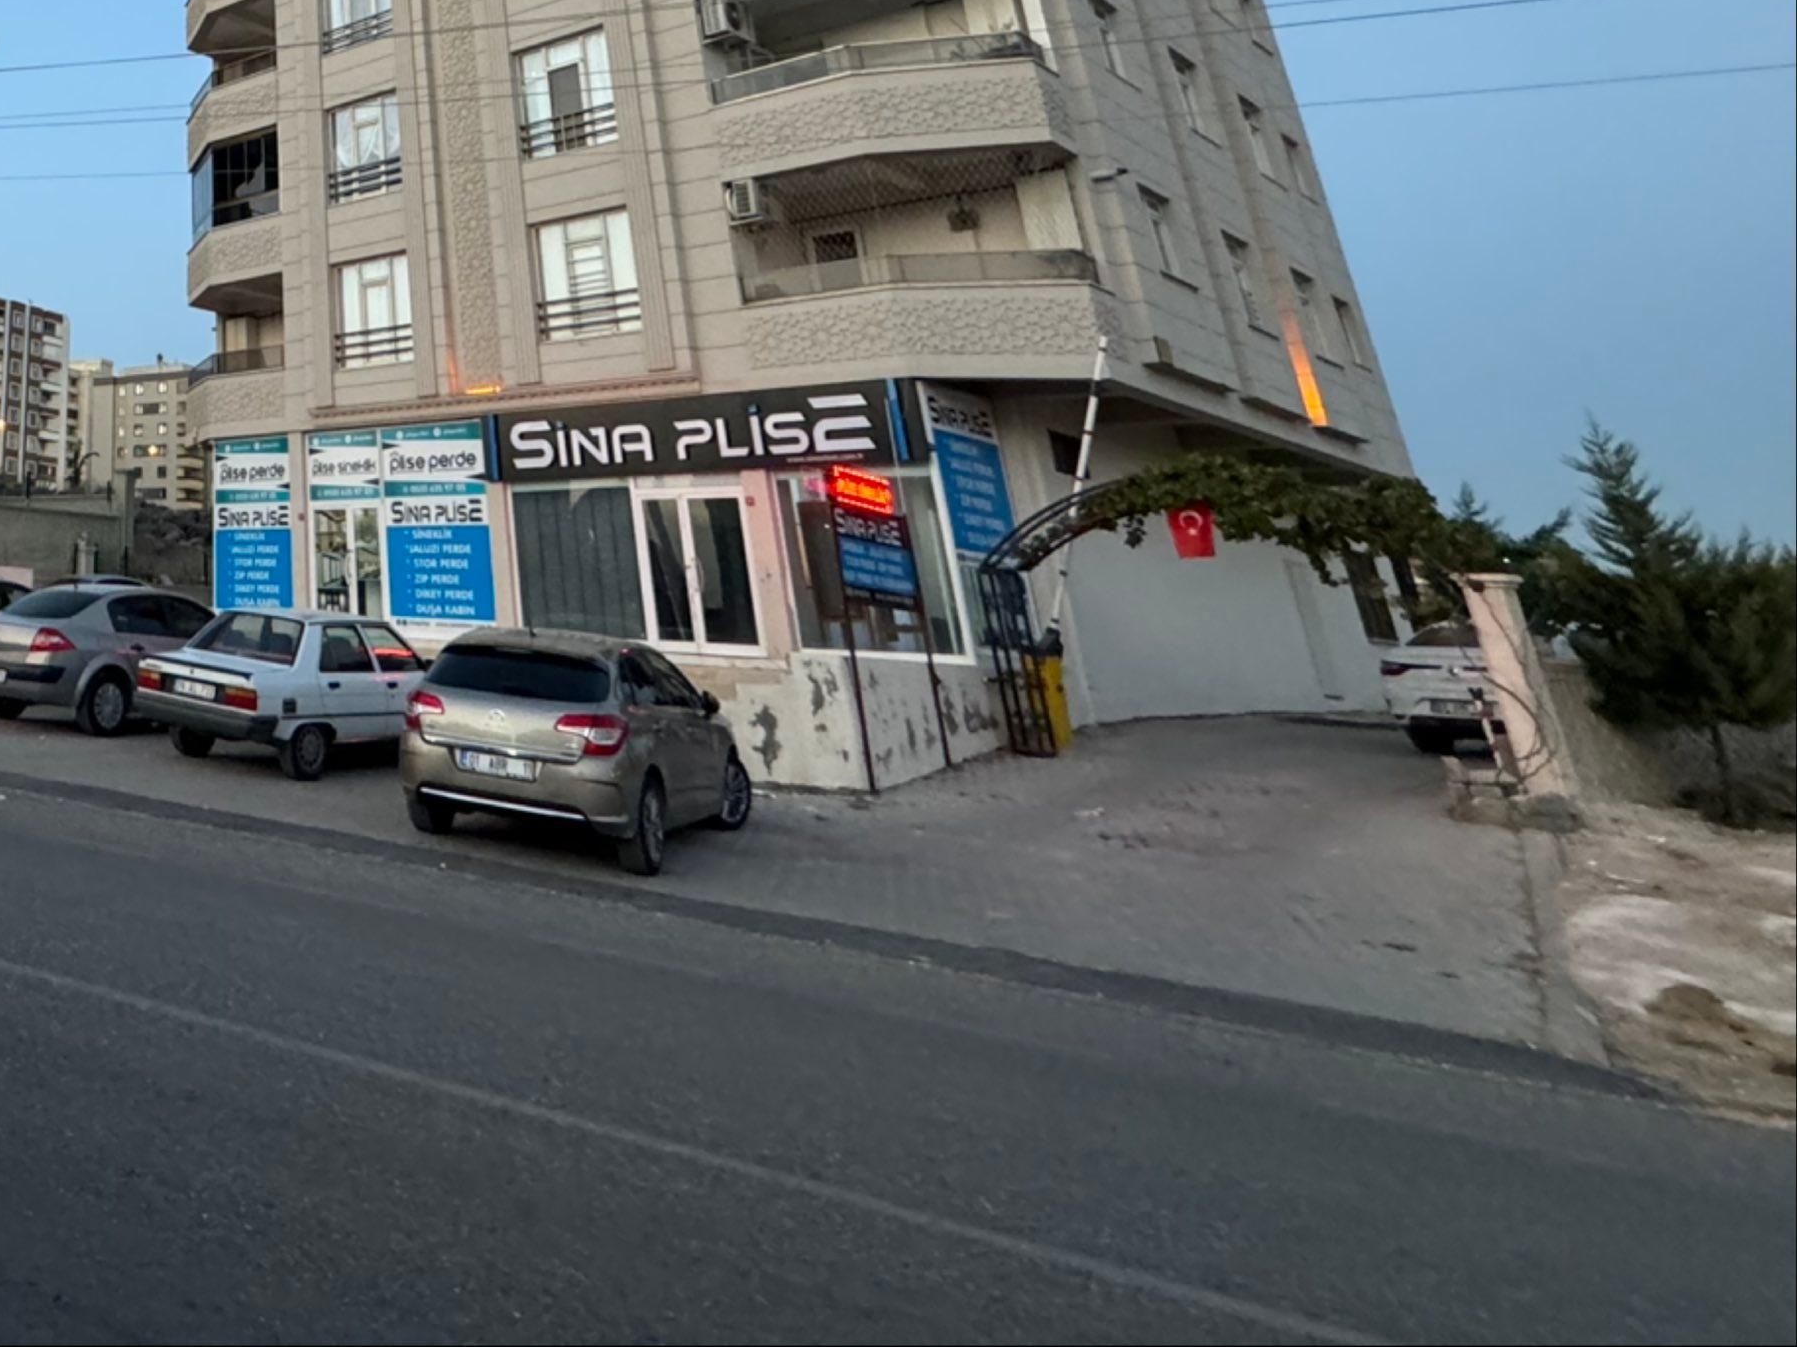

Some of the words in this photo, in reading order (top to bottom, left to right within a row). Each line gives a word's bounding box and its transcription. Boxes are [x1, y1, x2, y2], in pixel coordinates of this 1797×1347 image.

[428, 450, 476, 474] perde
[249, 462, 285, 483] perde
[442, 543, 471, 554] PERDE
[440, 558, 468, 569] PERDE
[431, 574, 460, 585] PERDE
[444, 589, 474, 601] PERDE
